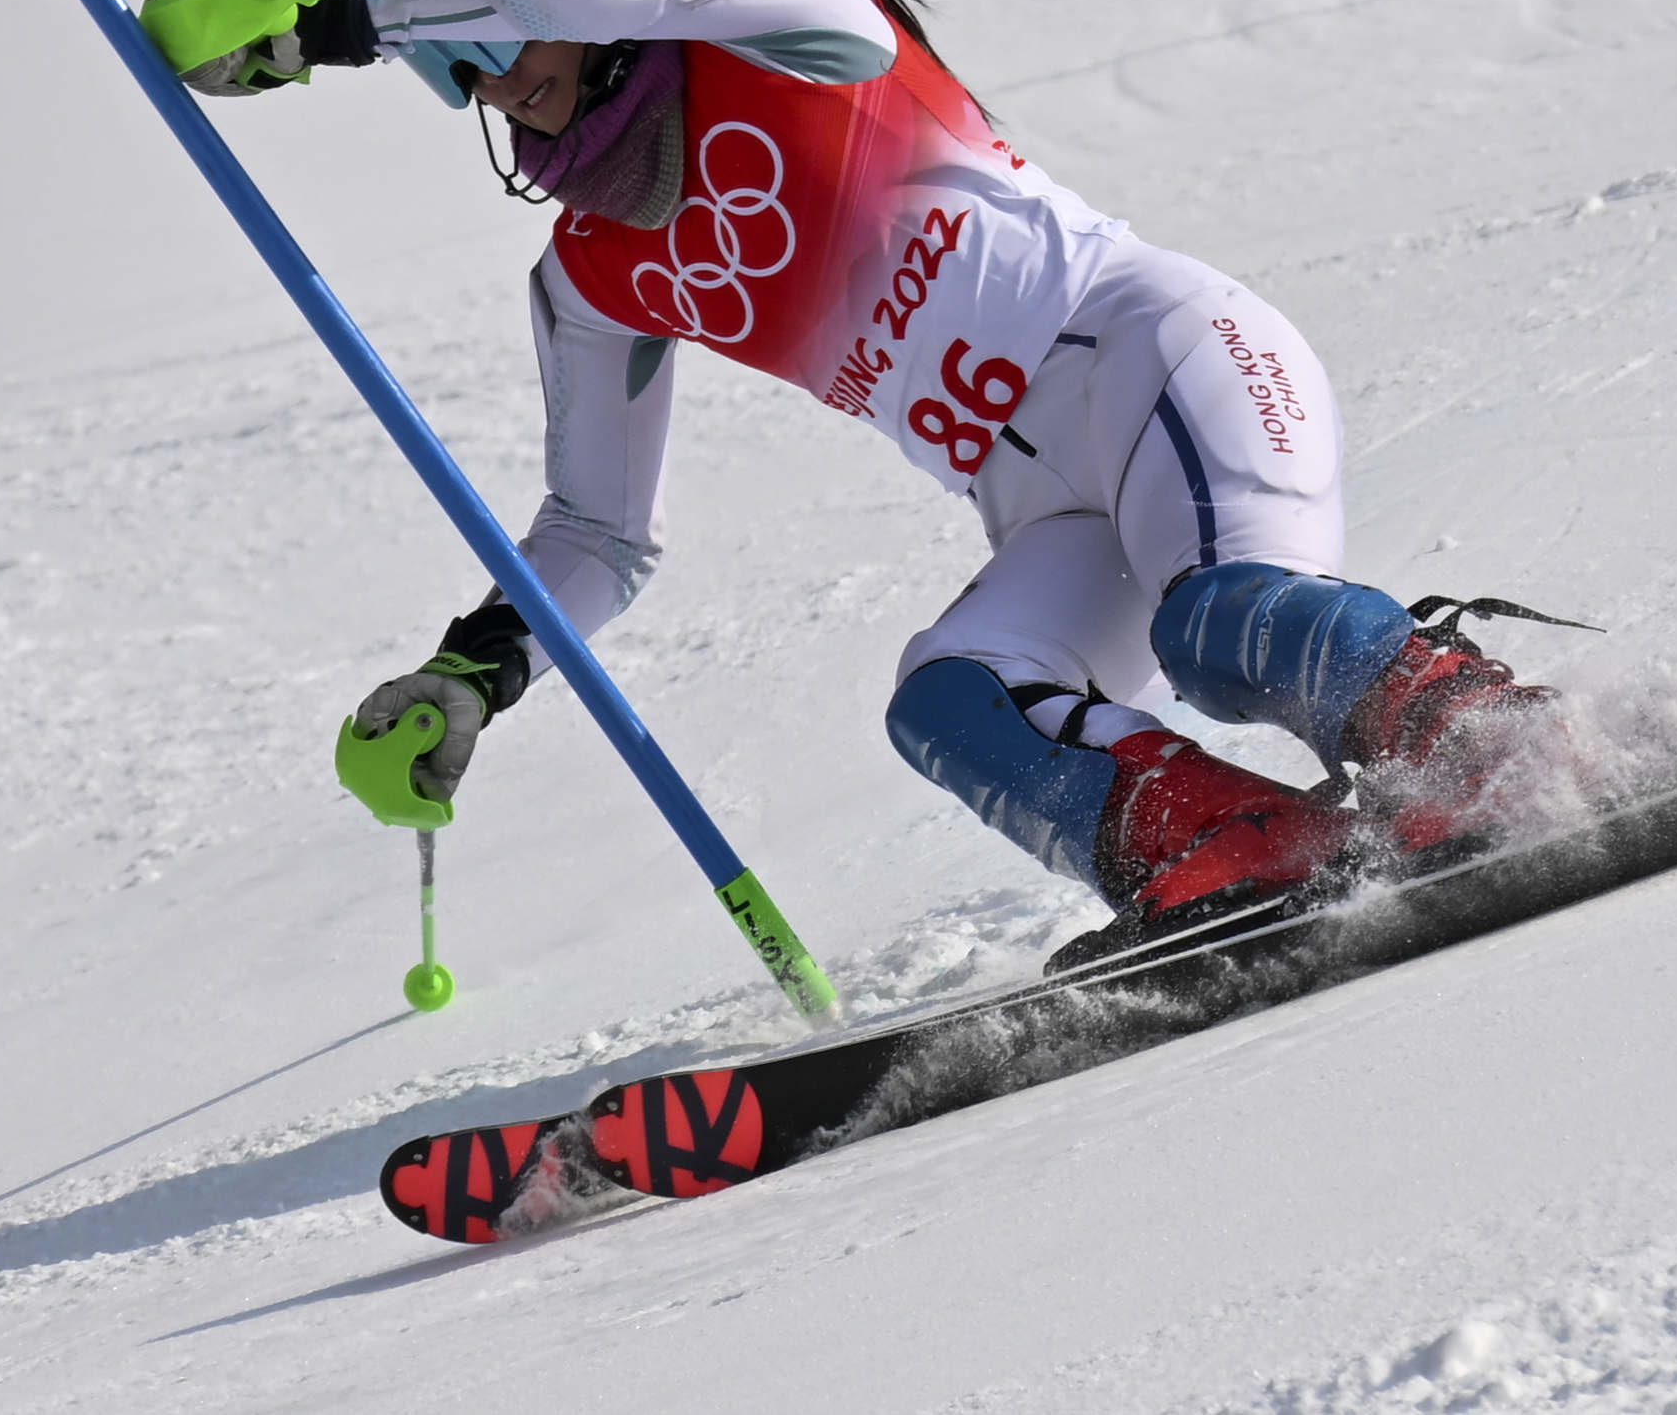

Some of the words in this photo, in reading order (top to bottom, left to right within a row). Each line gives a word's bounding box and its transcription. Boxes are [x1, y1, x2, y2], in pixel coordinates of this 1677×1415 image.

[873, 207, 972, 340] 2022
[1212, 317, 1263, 376] KONG
[908, 337, 1028, 476] 86
[1248, 384, 1294, 454] HONG
[1259, 352, 1306, 421] CHINA
